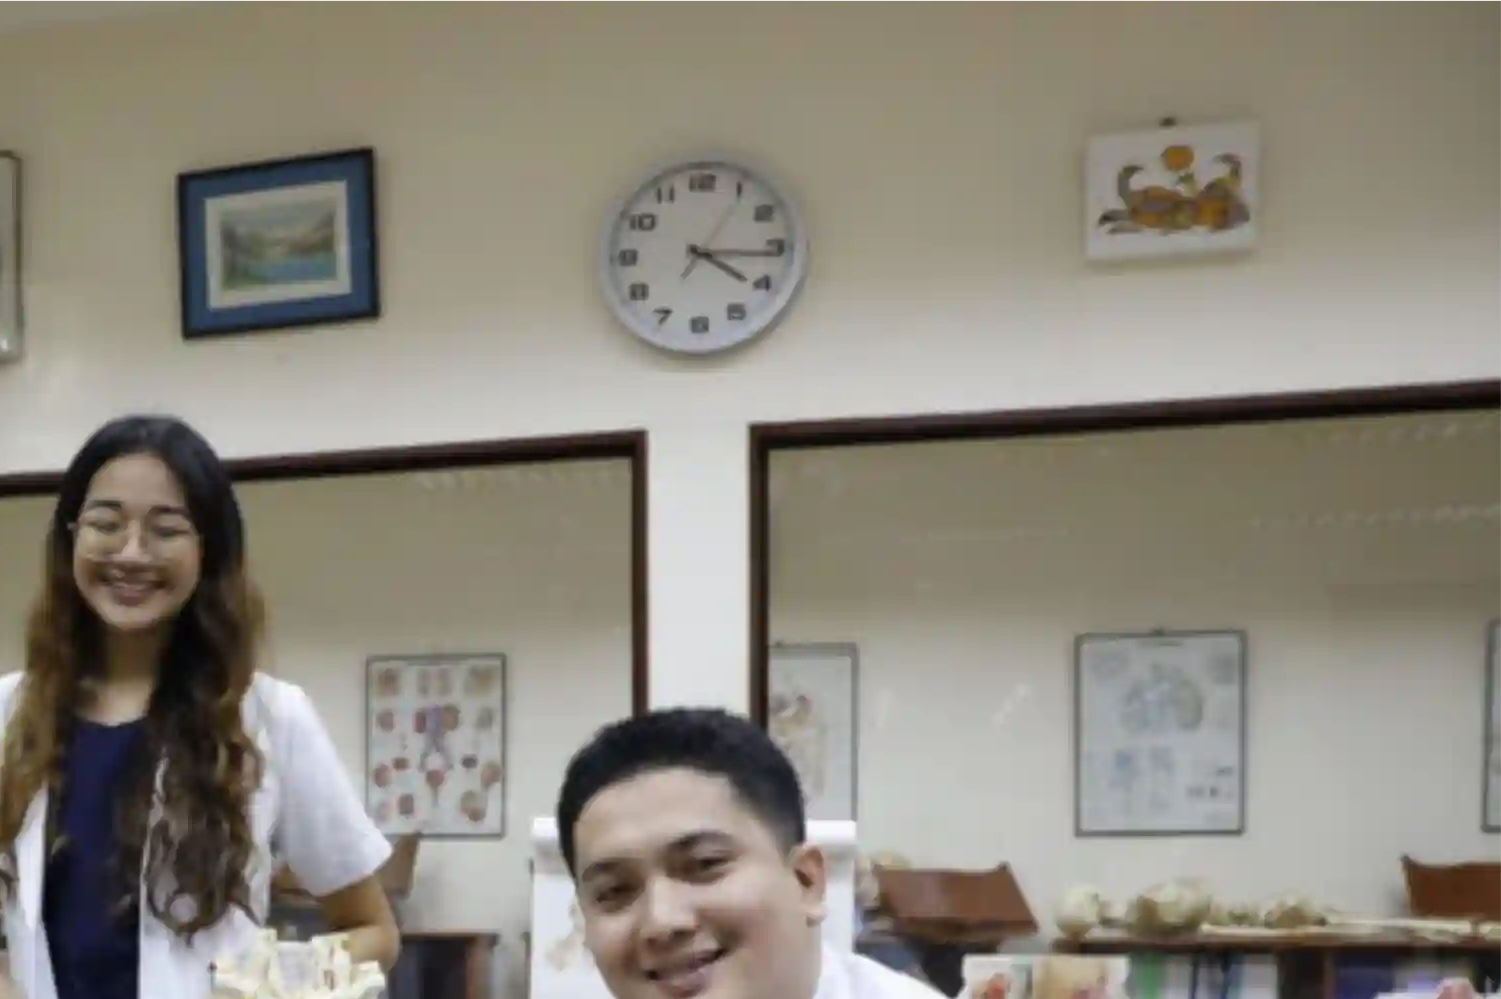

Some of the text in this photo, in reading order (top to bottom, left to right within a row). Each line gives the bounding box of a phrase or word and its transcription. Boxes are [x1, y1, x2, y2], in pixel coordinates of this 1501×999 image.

[656, 183, 676, 205] 11
[629, 212, 657, 231] 10
[752, 274, 772, 292] 4
[653, 306, 674, 326] 7
